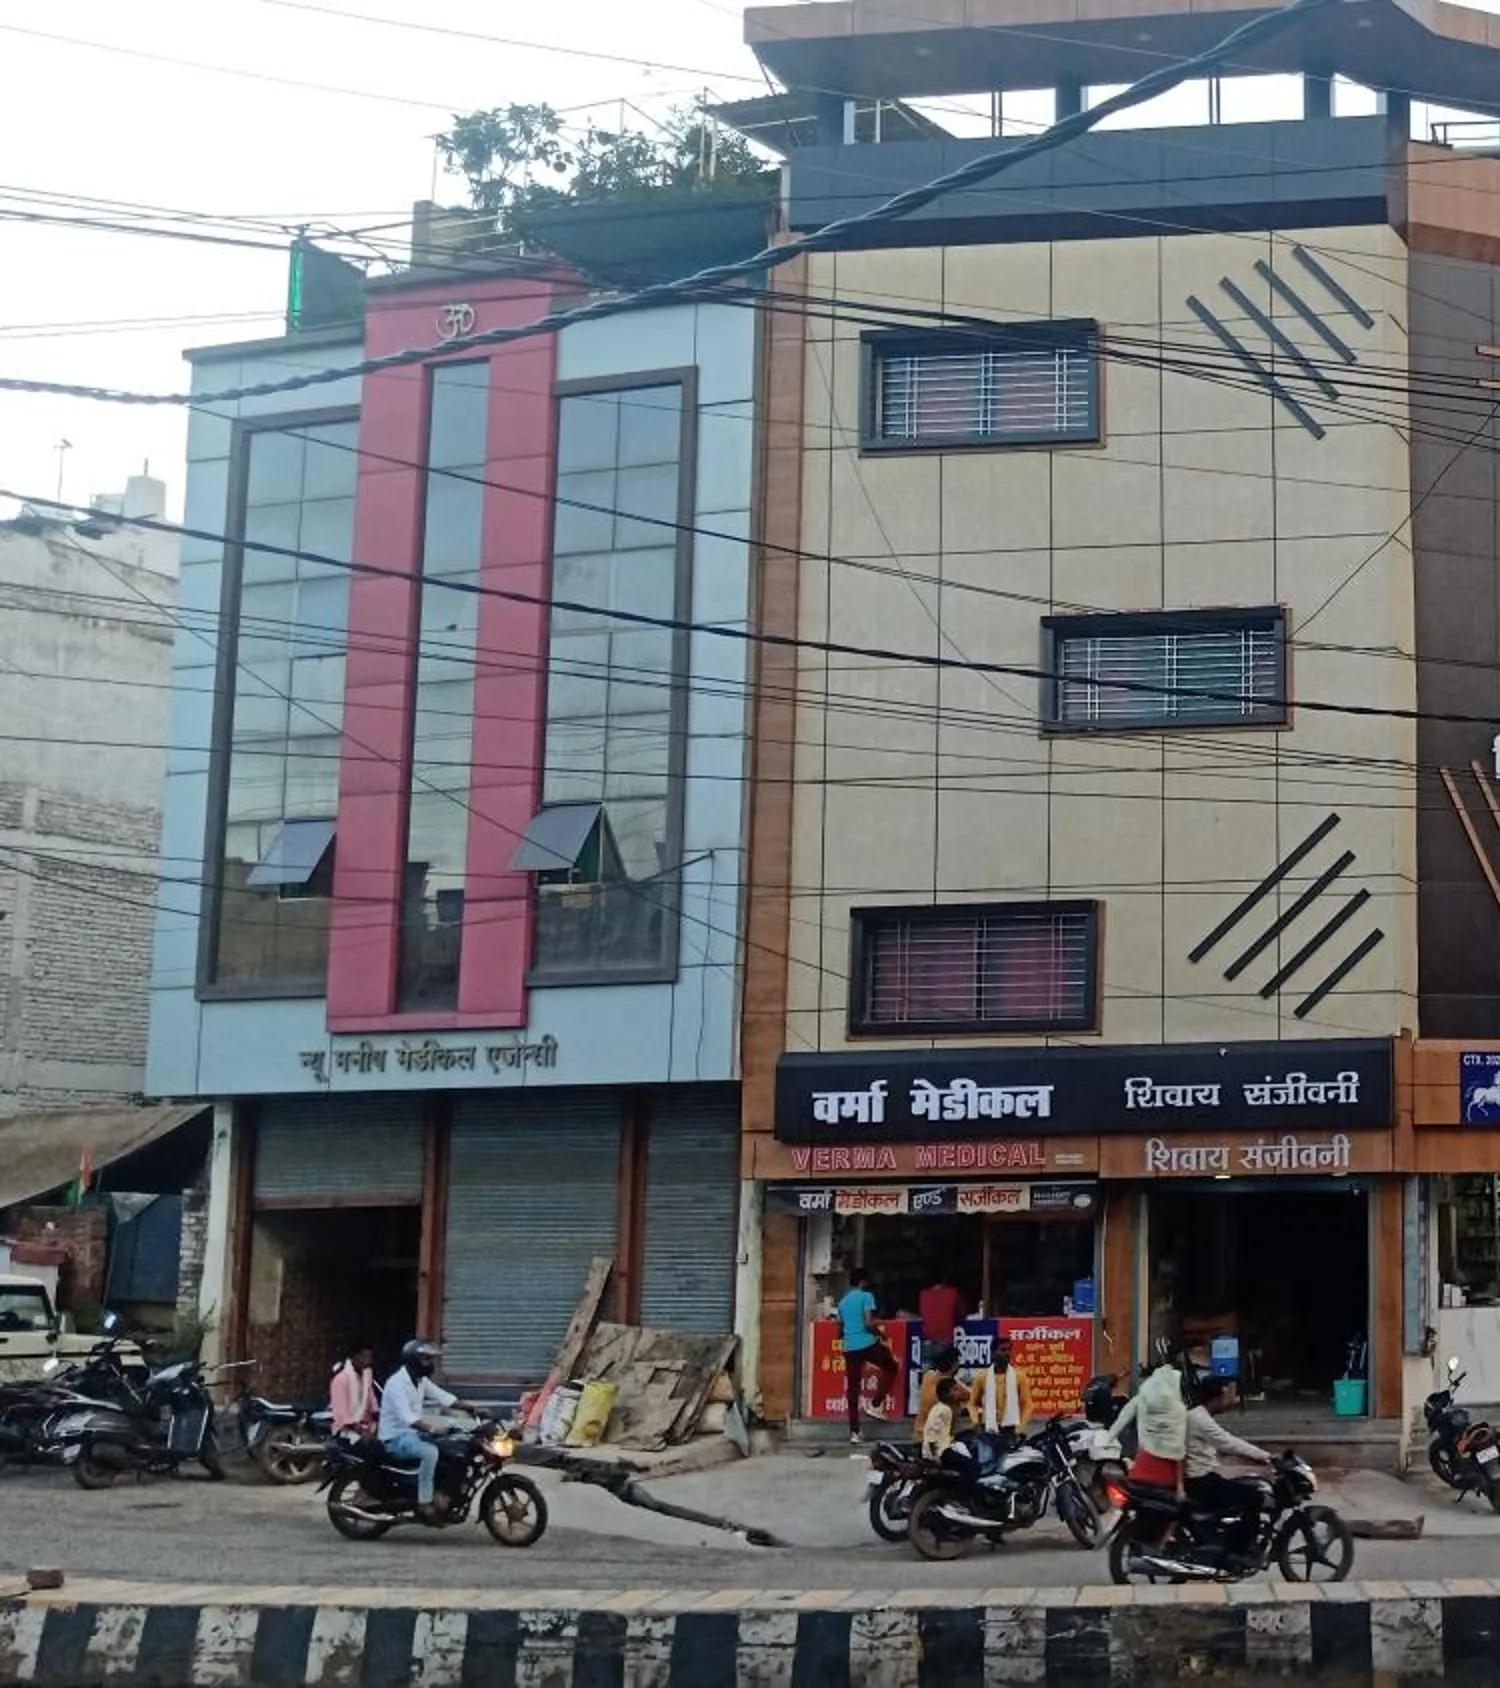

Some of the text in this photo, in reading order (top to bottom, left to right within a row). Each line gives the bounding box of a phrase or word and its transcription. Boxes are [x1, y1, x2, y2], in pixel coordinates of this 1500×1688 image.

[813, 1077, 1055, 1124] वर्मा मेडीकल
[1125, 1071, 1361, 1110] शिवाय संजीवनी
[792, 1143, 1046, 1171] VERMA MEDICAL
[1145, 1133, 1350, 1172] शिवाय संजीवनी
[799, 1188, 832, 1209] वर्मा
